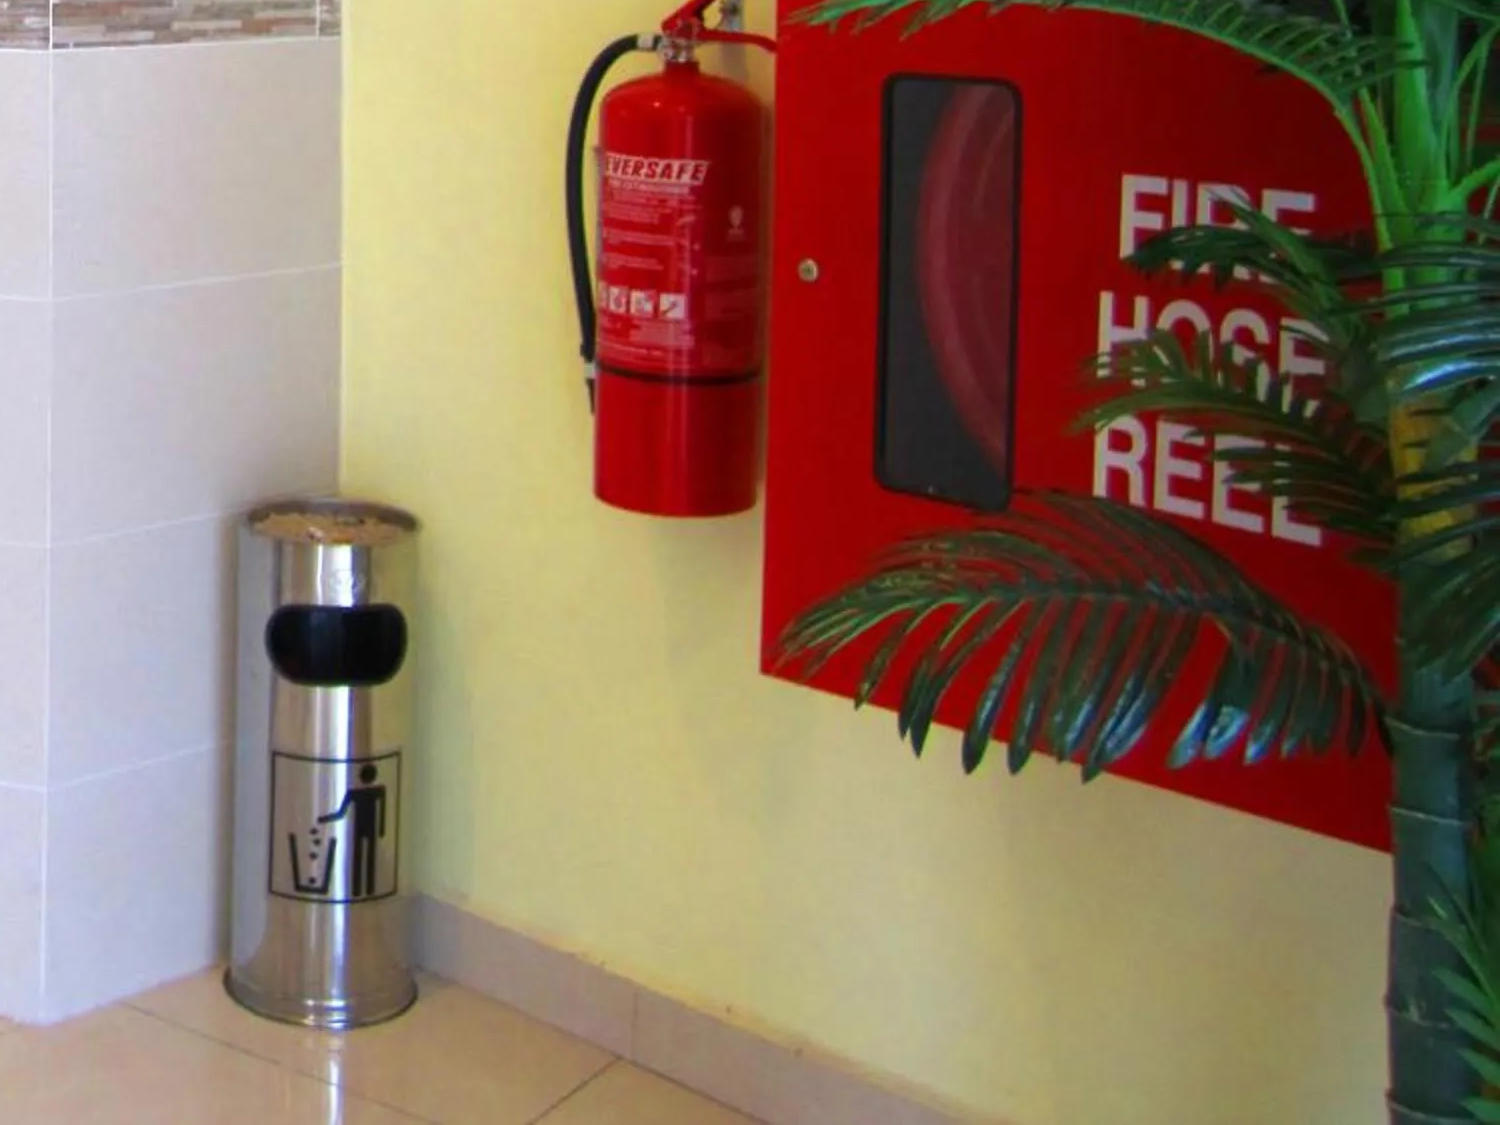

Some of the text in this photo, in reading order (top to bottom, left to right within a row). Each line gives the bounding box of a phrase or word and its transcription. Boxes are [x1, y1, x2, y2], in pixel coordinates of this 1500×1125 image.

[1119, 173, 1316, 285] FIRE
[1096, 290, 1330, 419] HOSE
[1092, 413, 1323, 547] REEL
